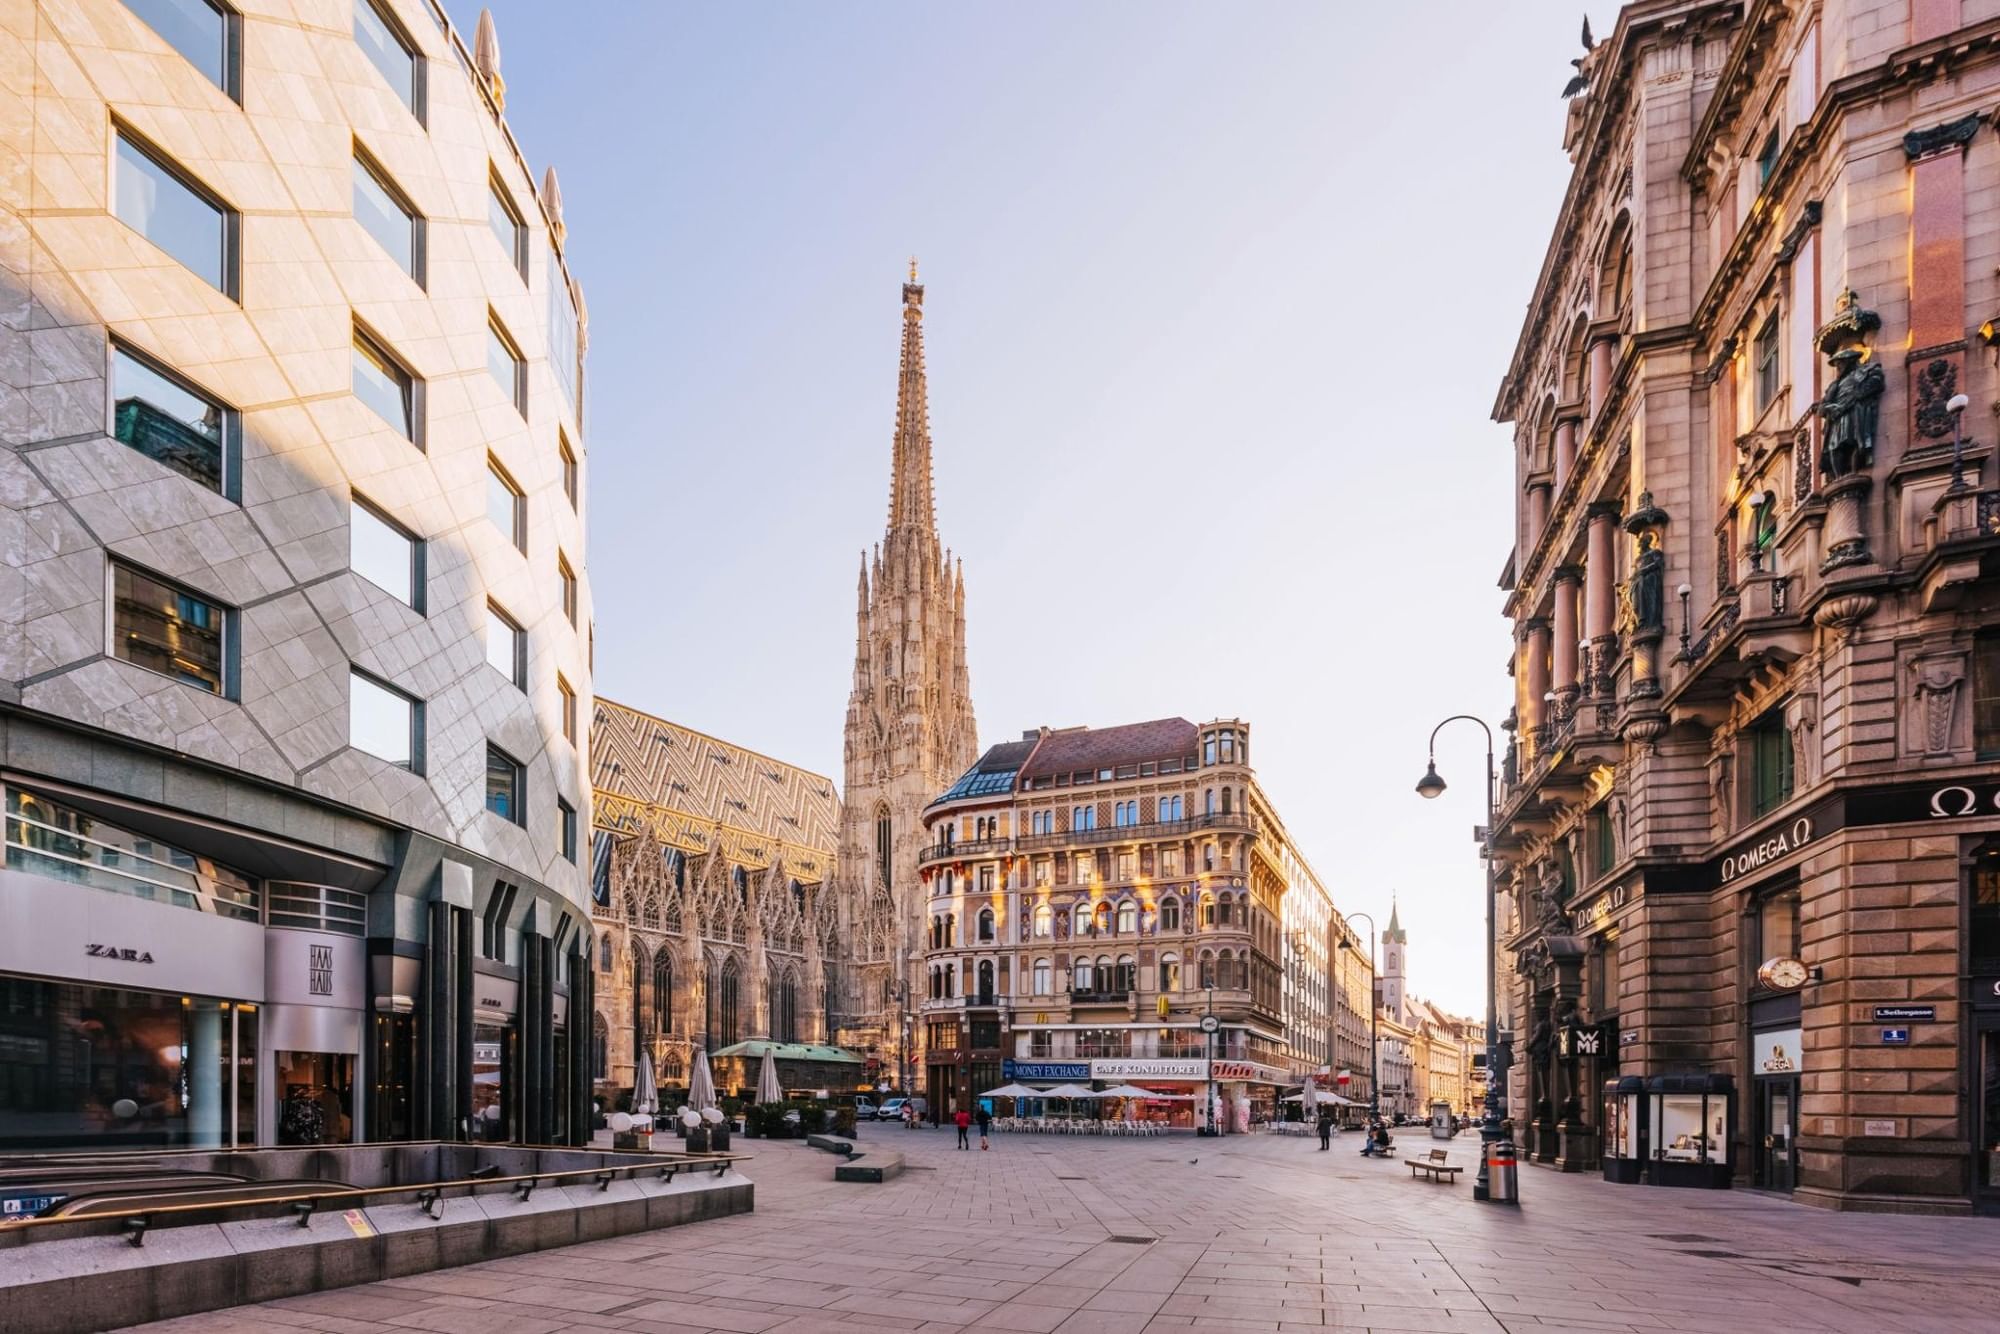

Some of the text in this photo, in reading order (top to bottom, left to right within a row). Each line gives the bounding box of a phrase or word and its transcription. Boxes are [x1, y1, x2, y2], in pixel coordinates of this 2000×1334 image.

[1738, 833, 1788, 873] OMEGA
[85, 944, 154, 964] ZARA
[310, 946, 333, 969] HAAS
[310, 971, 333, 993] HAUS
[1891, 1030, 1898, 1038] 1
[1016, 1065, 1043, 1077] MONEY
[1045, 1065, 1088, 1077] EXCHANGE
[1126, 1065, 1200, 1074] KONDITOREI
